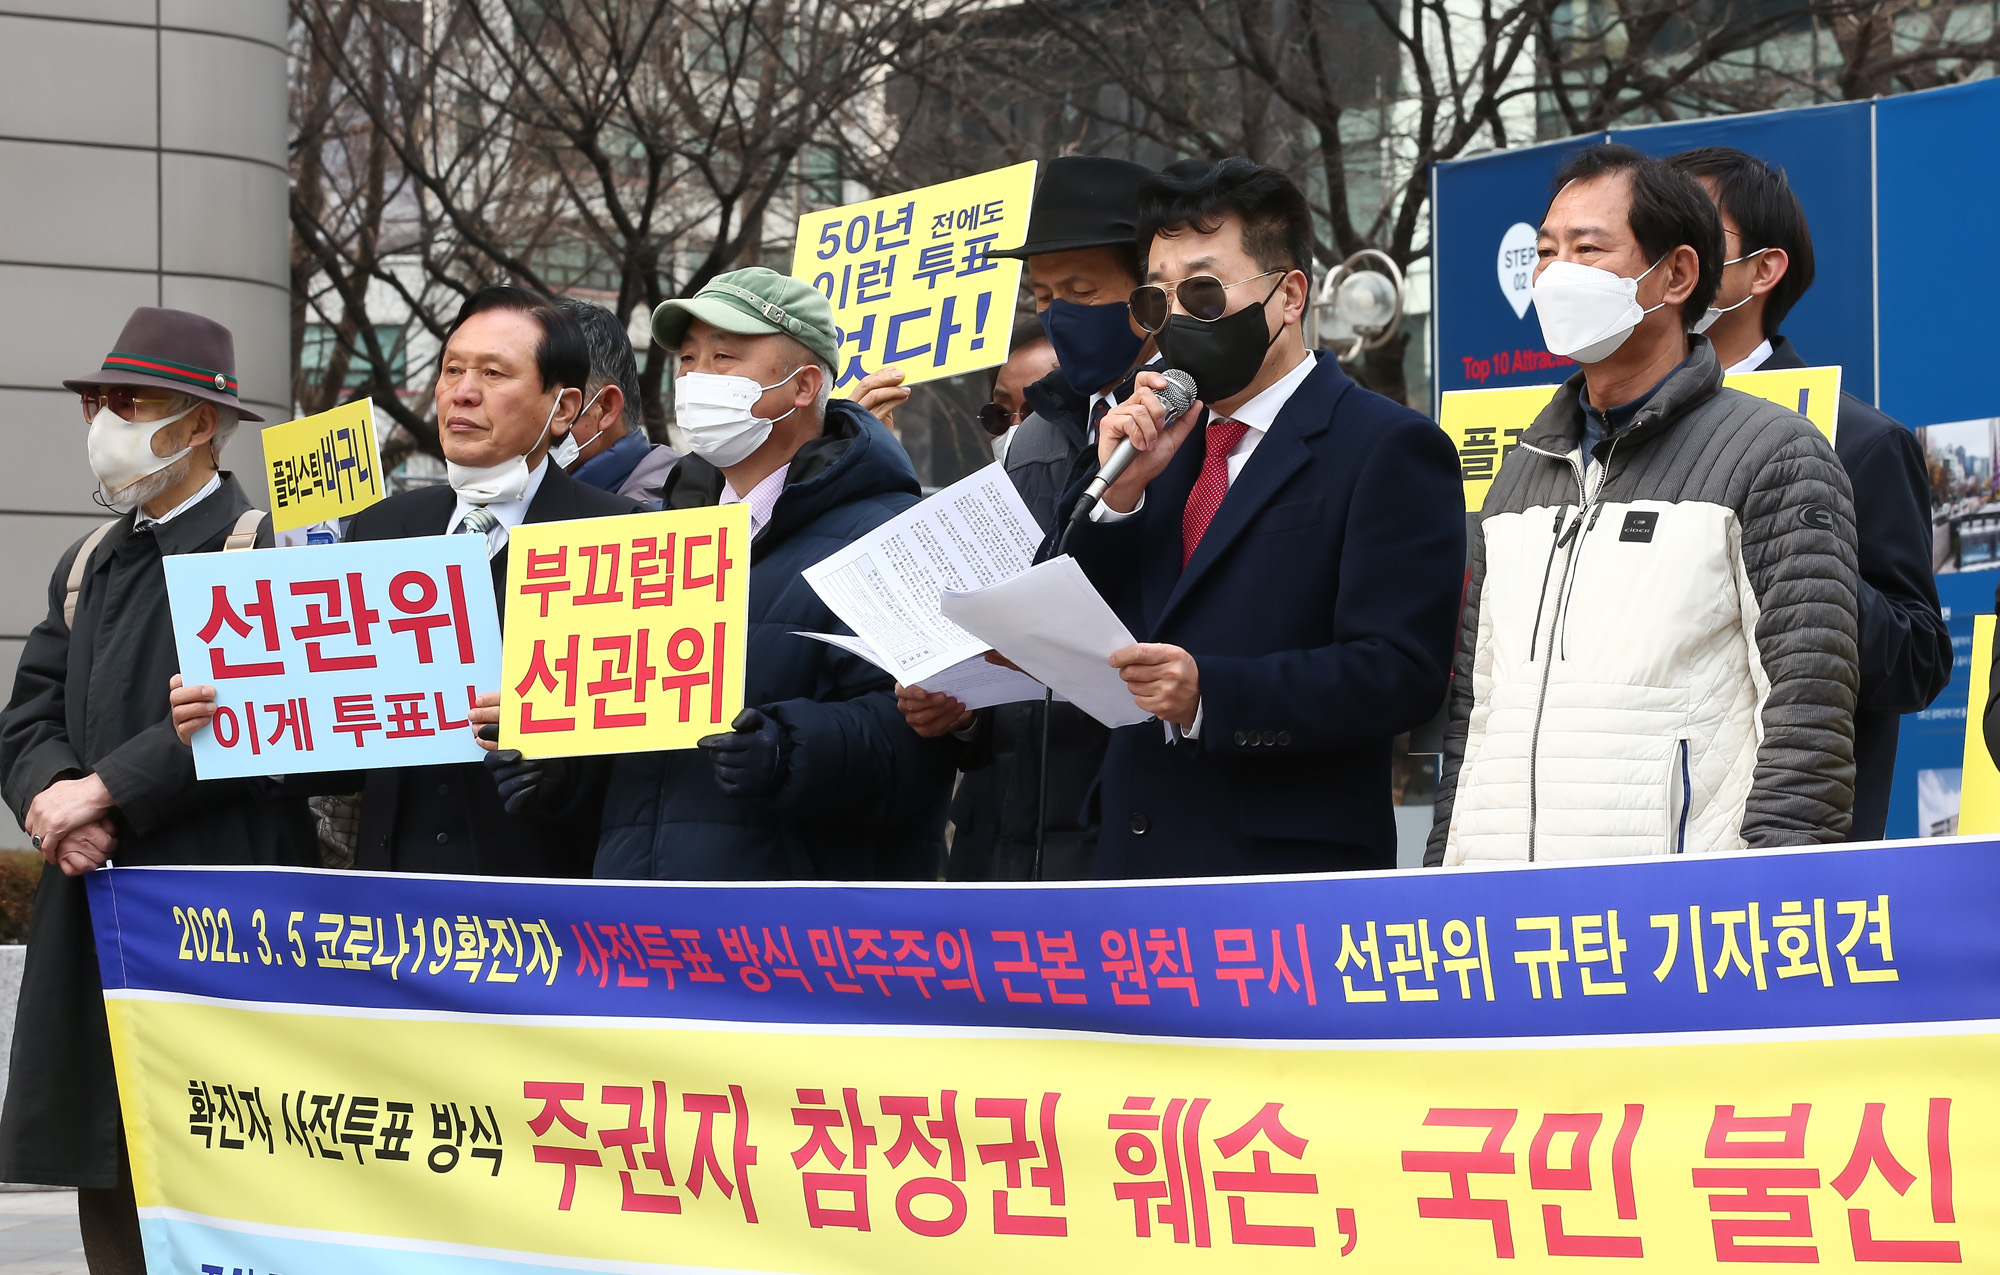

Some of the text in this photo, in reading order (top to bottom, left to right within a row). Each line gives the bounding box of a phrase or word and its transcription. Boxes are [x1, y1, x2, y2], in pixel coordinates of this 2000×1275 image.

[817, 200, 1004, 261] 50년 전에도
[1504, 247, 1537, 268] STEP
[813, 232, 999, 310] 이런 투표
[1513, 273, 1528, 291] 02
[1462, 356, 1491, 384] Top
[1492, 351, 1511, 376] 10
[520, 527, 733, 618] 부끄럽다
[196, 564, 476, 680] 선관위
[514, 621, 726, 735] 선관위
[213, 698, 315, 755] 이게
[173, 893, 1900, 1007] 2022. 3. 5 코로나19확진자 사전투표 방식 민주주의 근본 원칙 무시 선관위 규탄 기자회견
[187, 1079, 1963, 1264] 확진자 사전투표 방식 주권자 참정권 훼손, 국민 불신
